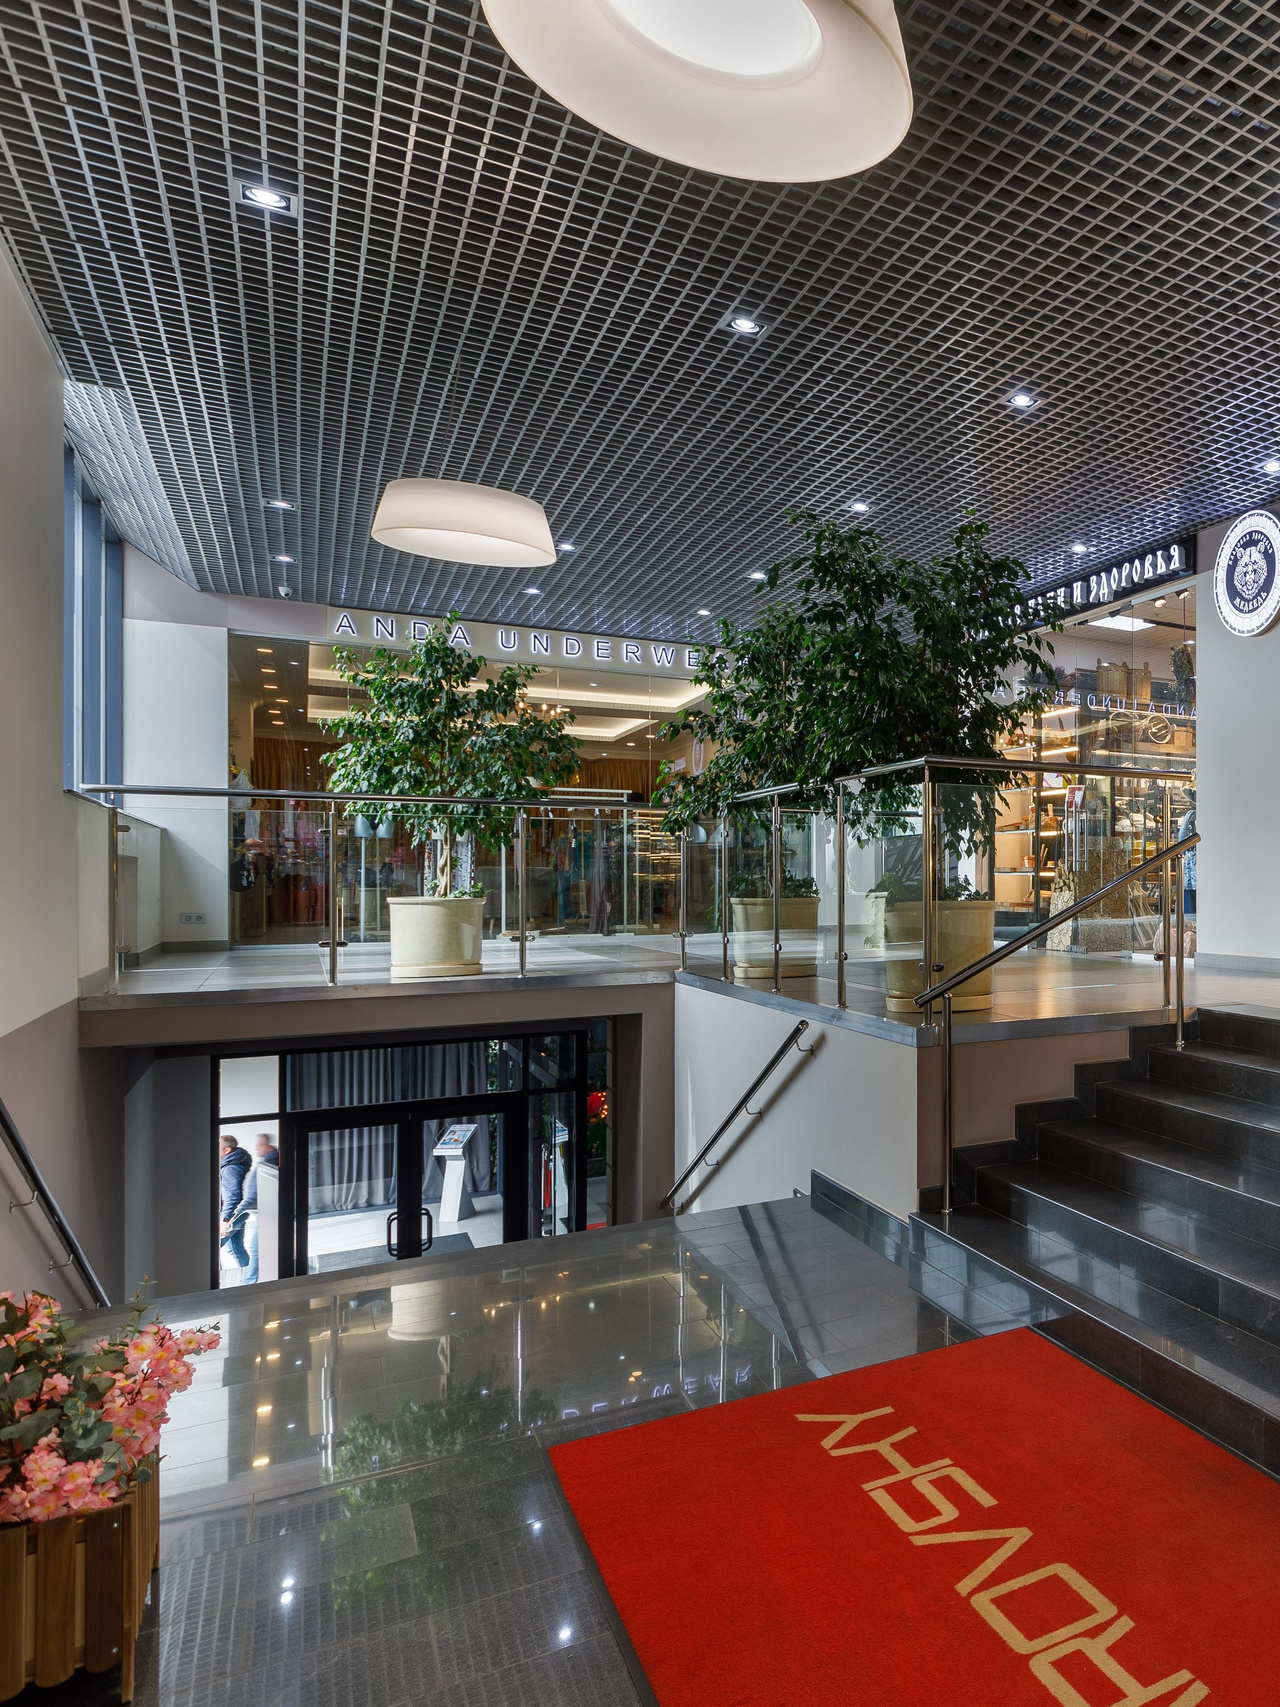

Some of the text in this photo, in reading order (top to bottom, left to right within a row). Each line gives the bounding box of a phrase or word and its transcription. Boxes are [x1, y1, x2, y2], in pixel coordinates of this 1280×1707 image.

[1072, 580, 1085, 605] И
[1089, 544, 1183, 604] ЗДОРОВЬЯ
[1233, 591, 1268, 613] МЕДВЕДЬ
[335, 613, 748, 675] ANDA UNDERWE
